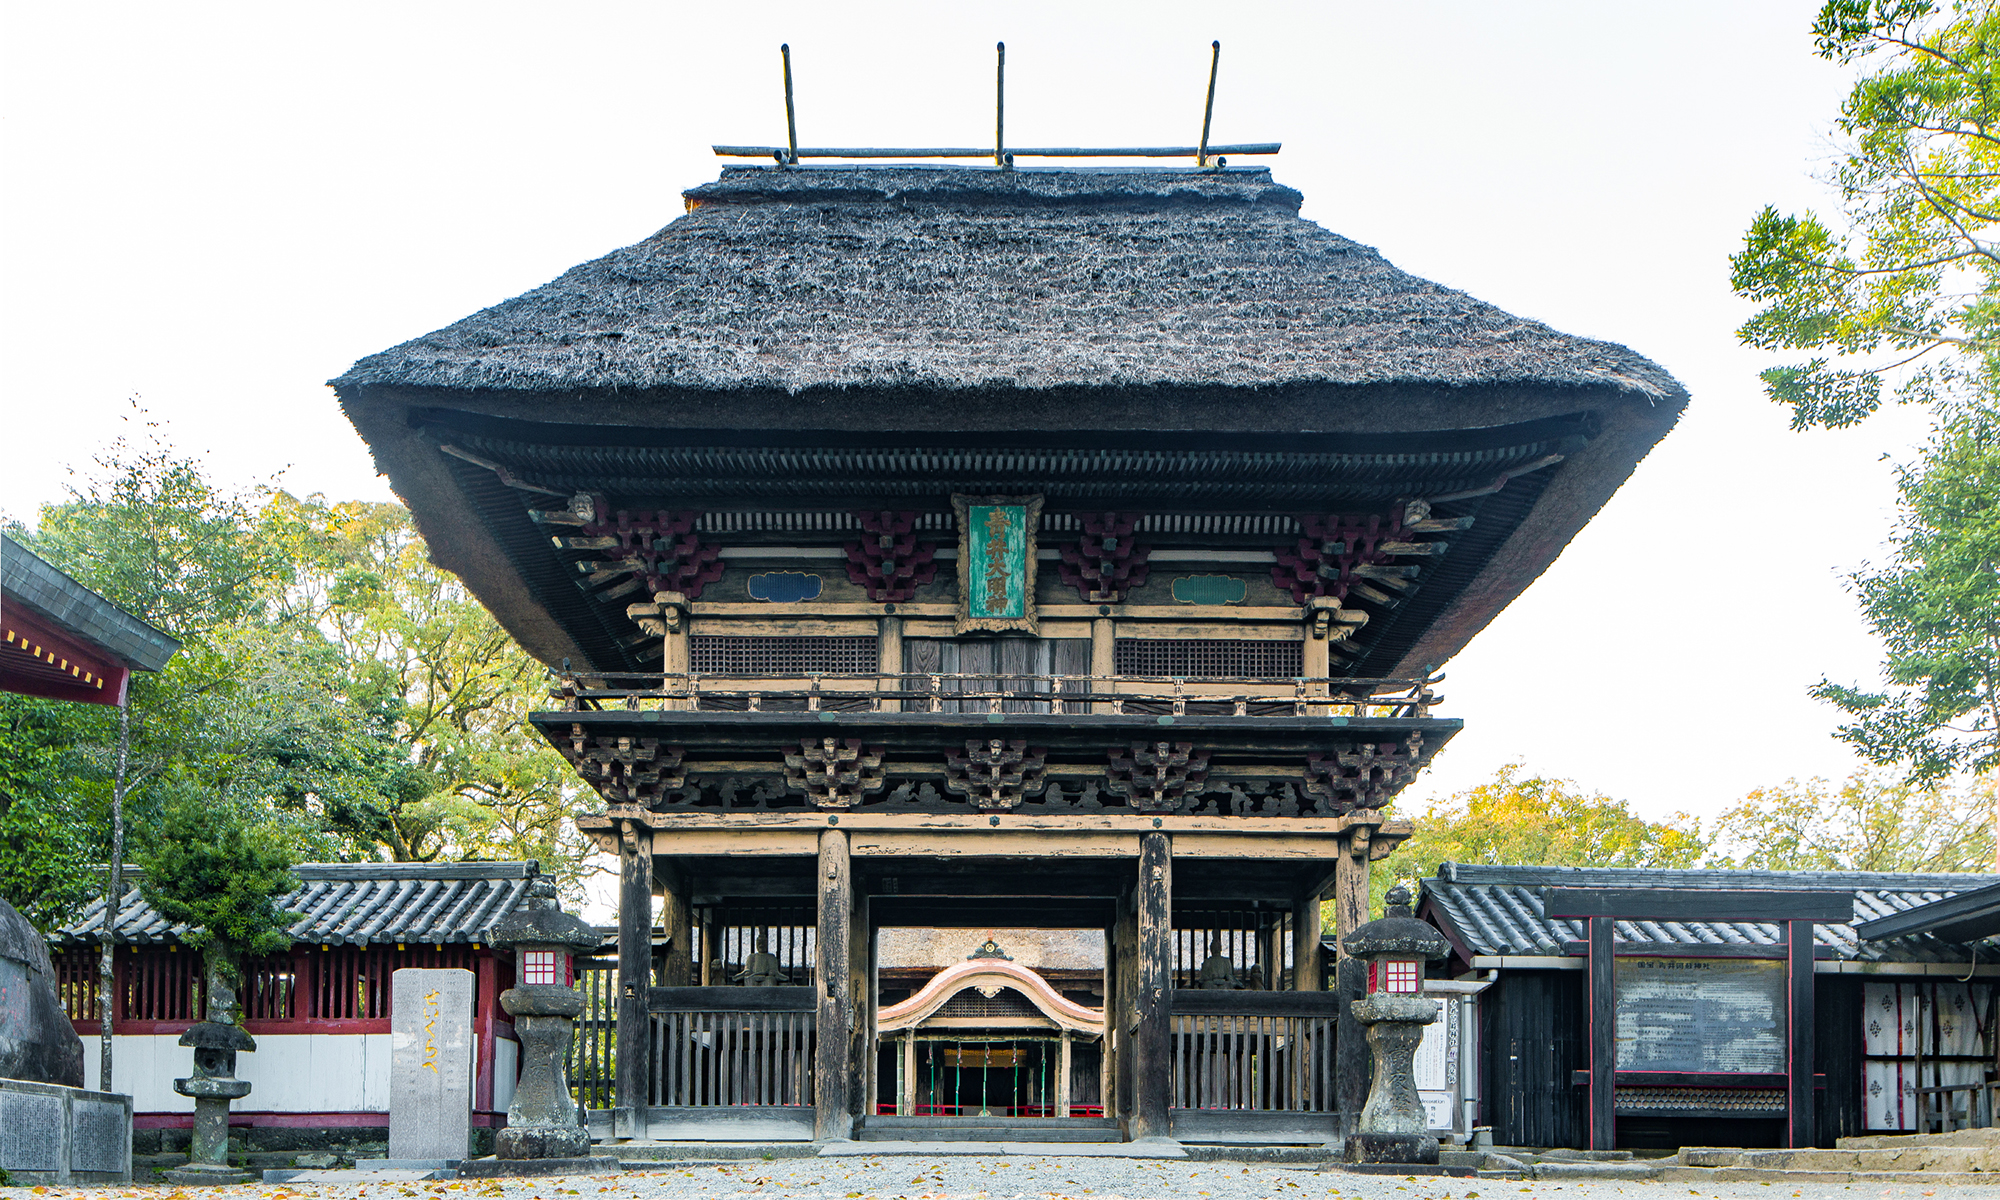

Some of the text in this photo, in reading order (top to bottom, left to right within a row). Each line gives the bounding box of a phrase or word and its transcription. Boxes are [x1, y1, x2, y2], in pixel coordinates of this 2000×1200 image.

[984, 507, 1012, 614] 青井大明神
[422, 988, 440, 1074] せいくらべ
